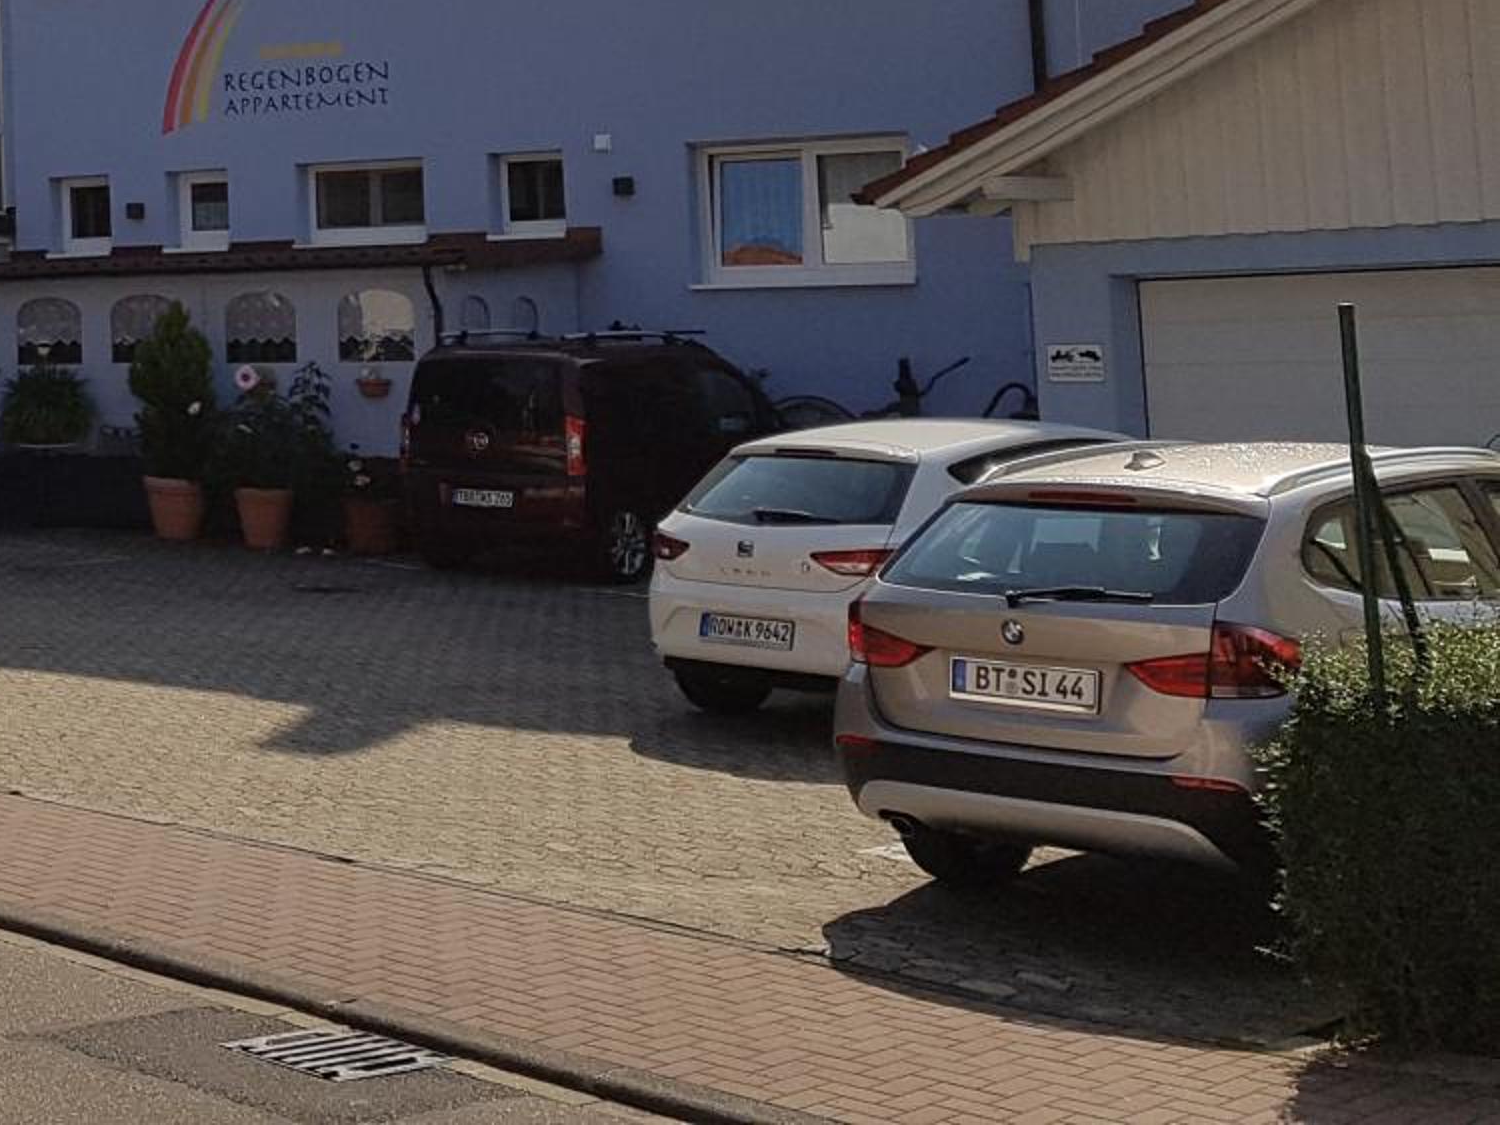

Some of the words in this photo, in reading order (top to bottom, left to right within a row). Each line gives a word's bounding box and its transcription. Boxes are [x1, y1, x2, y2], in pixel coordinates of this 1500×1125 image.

[224, 61, 389, 92] REGENBOGEN
[224, 87, 389, 116] APPARTEMENT
[975, 666, 1006, 692] BT
[1022, 670, 1049, 697] SI
[1055, 675, 1084, 700] 44
